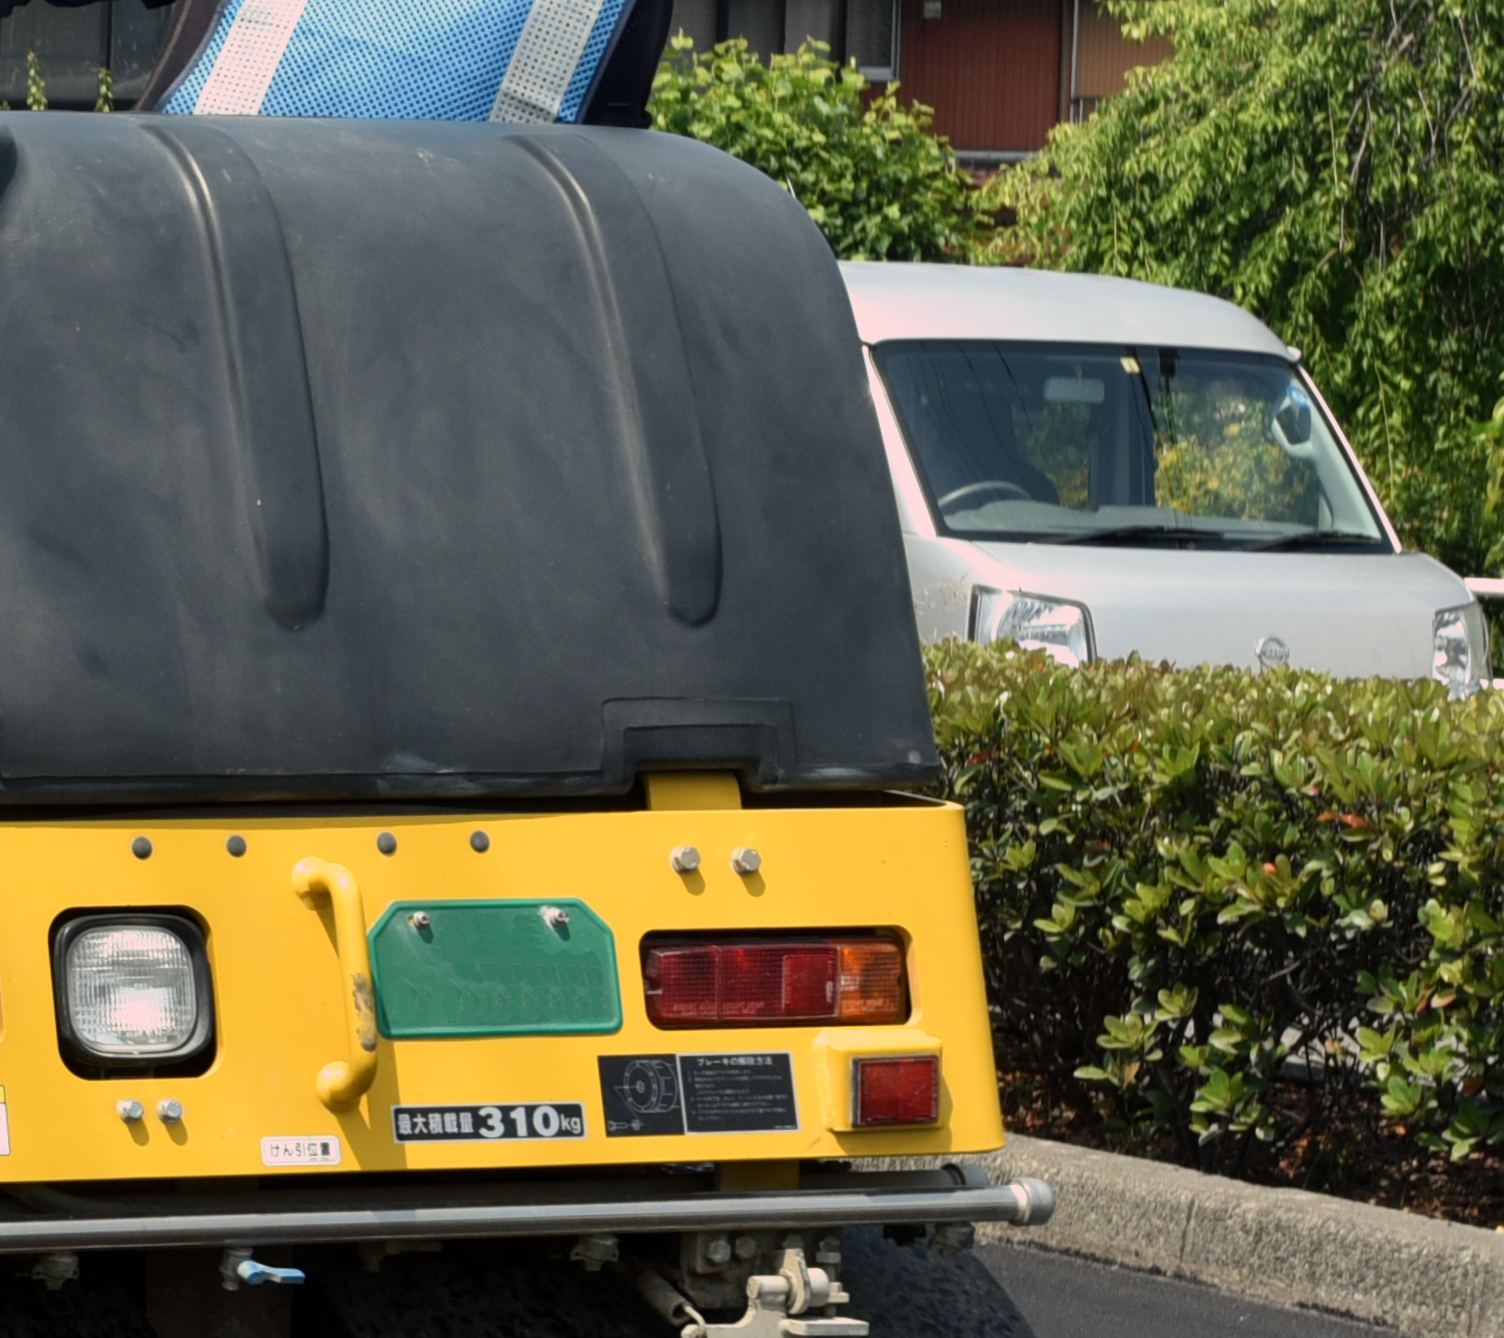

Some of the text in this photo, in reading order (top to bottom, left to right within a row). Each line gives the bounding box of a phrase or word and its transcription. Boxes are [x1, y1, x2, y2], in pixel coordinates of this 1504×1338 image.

[270, 1142, 331, 1157] けん引位置
